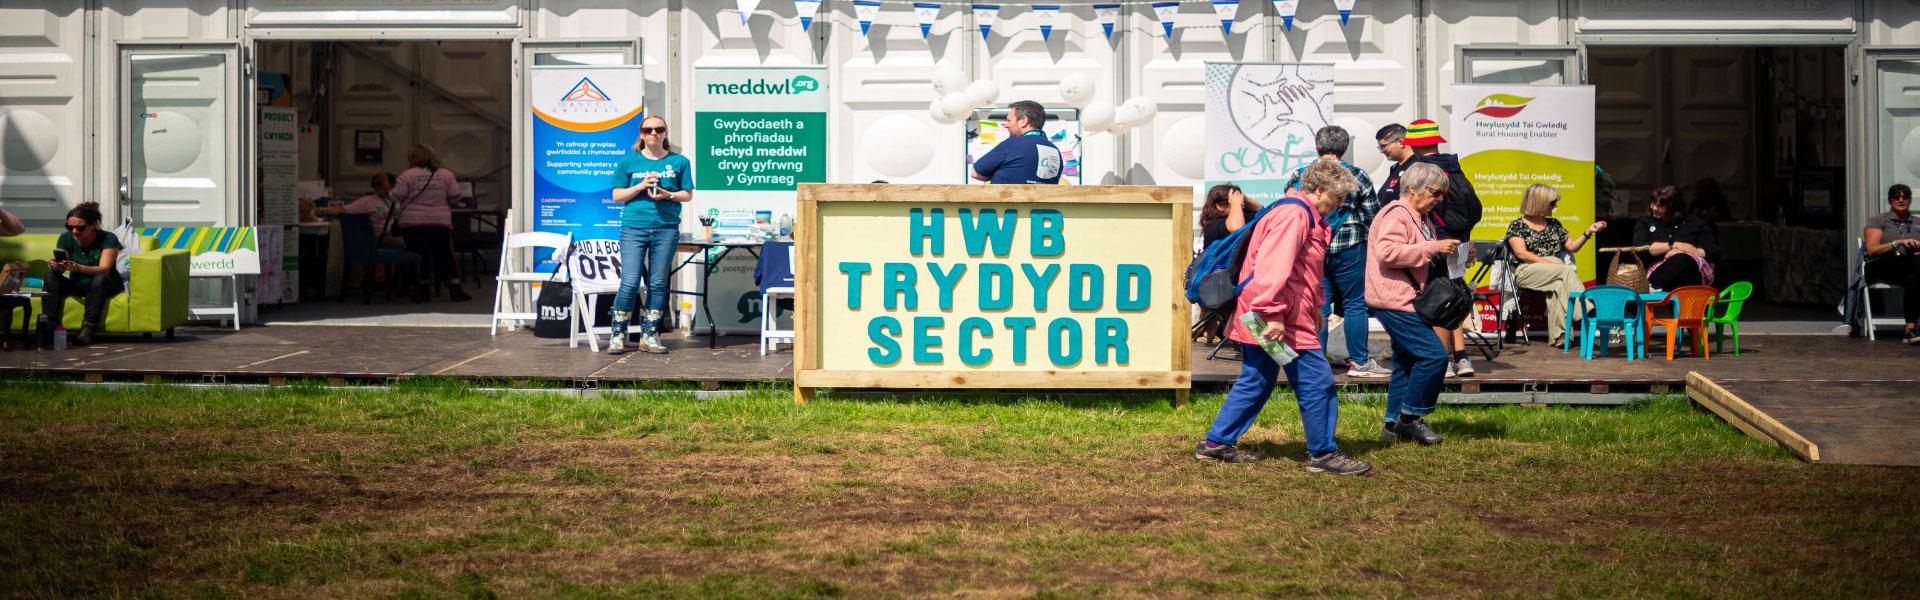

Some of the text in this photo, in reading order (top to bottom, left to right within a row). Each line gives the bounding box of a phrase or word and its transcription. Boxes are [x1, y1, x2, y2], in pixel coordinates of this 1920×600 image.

[708, 79, 814, 95] meddwl .org
[714, 118, 804, 131] Gwybodaeth a
[1476, 121, 1567, 130] Hwylusydd Tai Gwledig
[724, 132, 793, 145] phrofiadau
[1476, 130, 1557, 139] Rural Housing Enabler
[565, 141, 589, 149] cefnogi
[589, 141, 616, 149] grwpiau
[711, 145, 807, 158] iechyd meddwl
[546, 160, 582, 168] Supporting
[718, 159, 803, 172] drwy gyfrwng
[726, 173, 794, 186] y Gymraeg
[1474, 173, 1517, 181] Hwylusydd
[910, 207, 1065, 257] HWB
[575, 240, 620, 256] AID A BO
[839, 261, 1152, 312] TRYDYDD
[867, 315, 1130, 367] SECTOR
